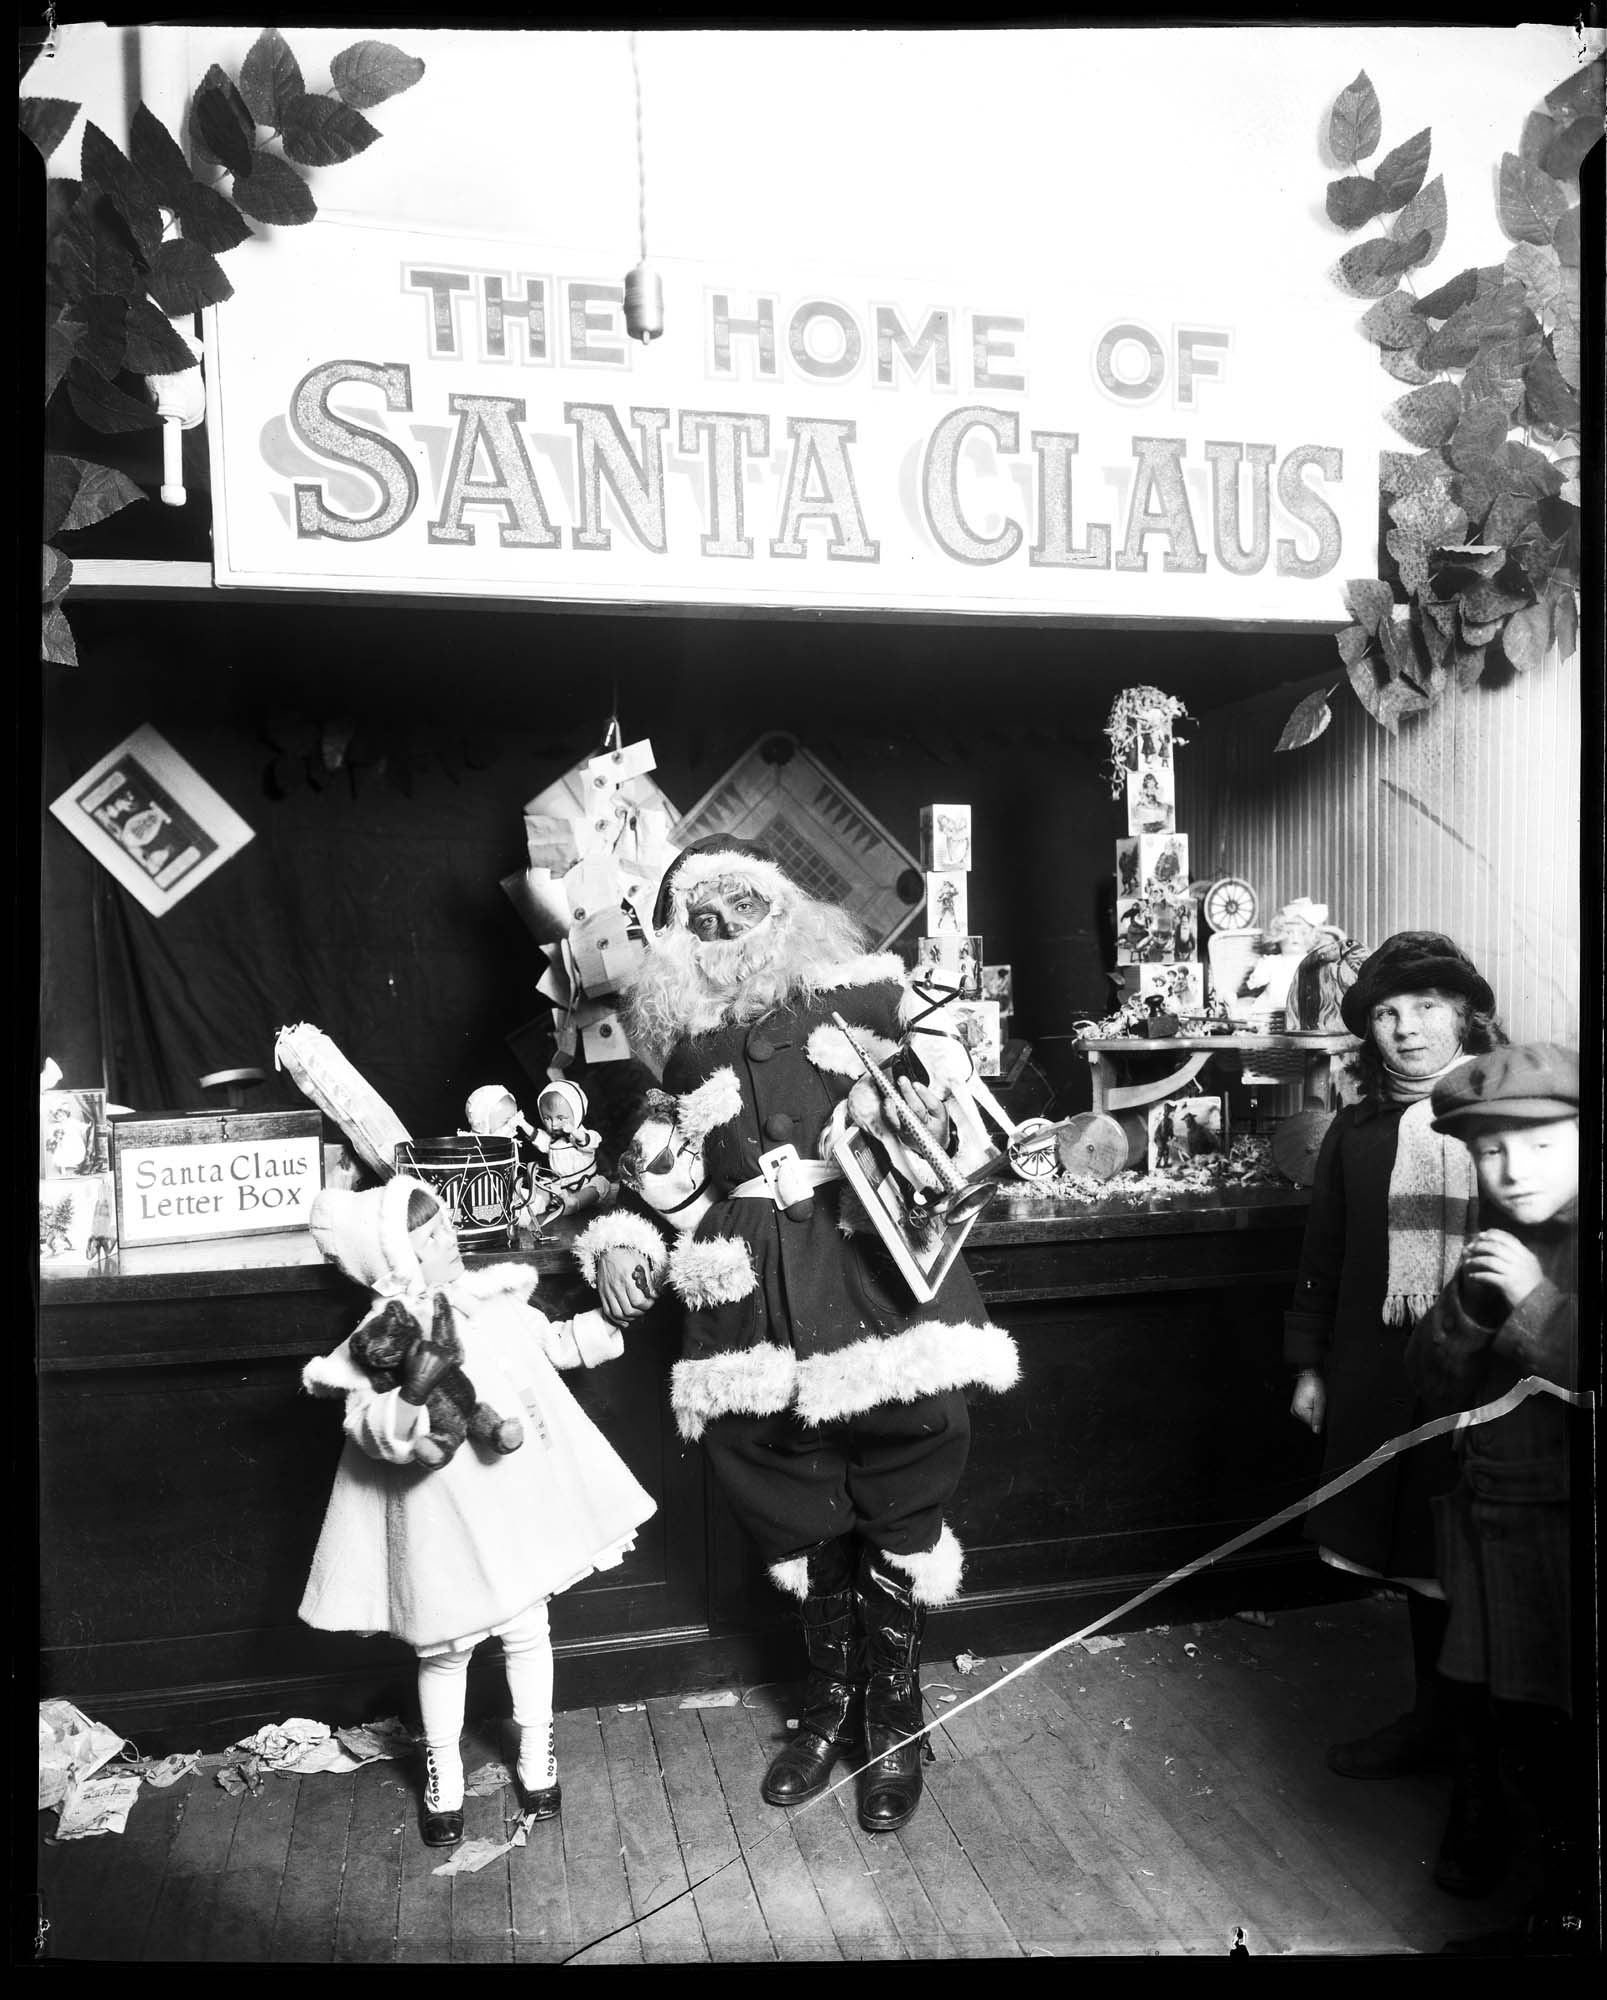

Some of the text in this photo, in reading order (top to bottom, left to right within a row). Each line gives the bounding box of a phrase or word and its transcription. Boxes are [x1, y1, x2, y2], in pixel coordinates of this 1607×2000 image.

[402, 262, 1236, 411] THE HOME OF
[289, 359, 1343, 578] SANTA CLAUS
[136, 1151, 308, 1189] Santa Claus
[141, 1185, 302, 1219] Letter Box
